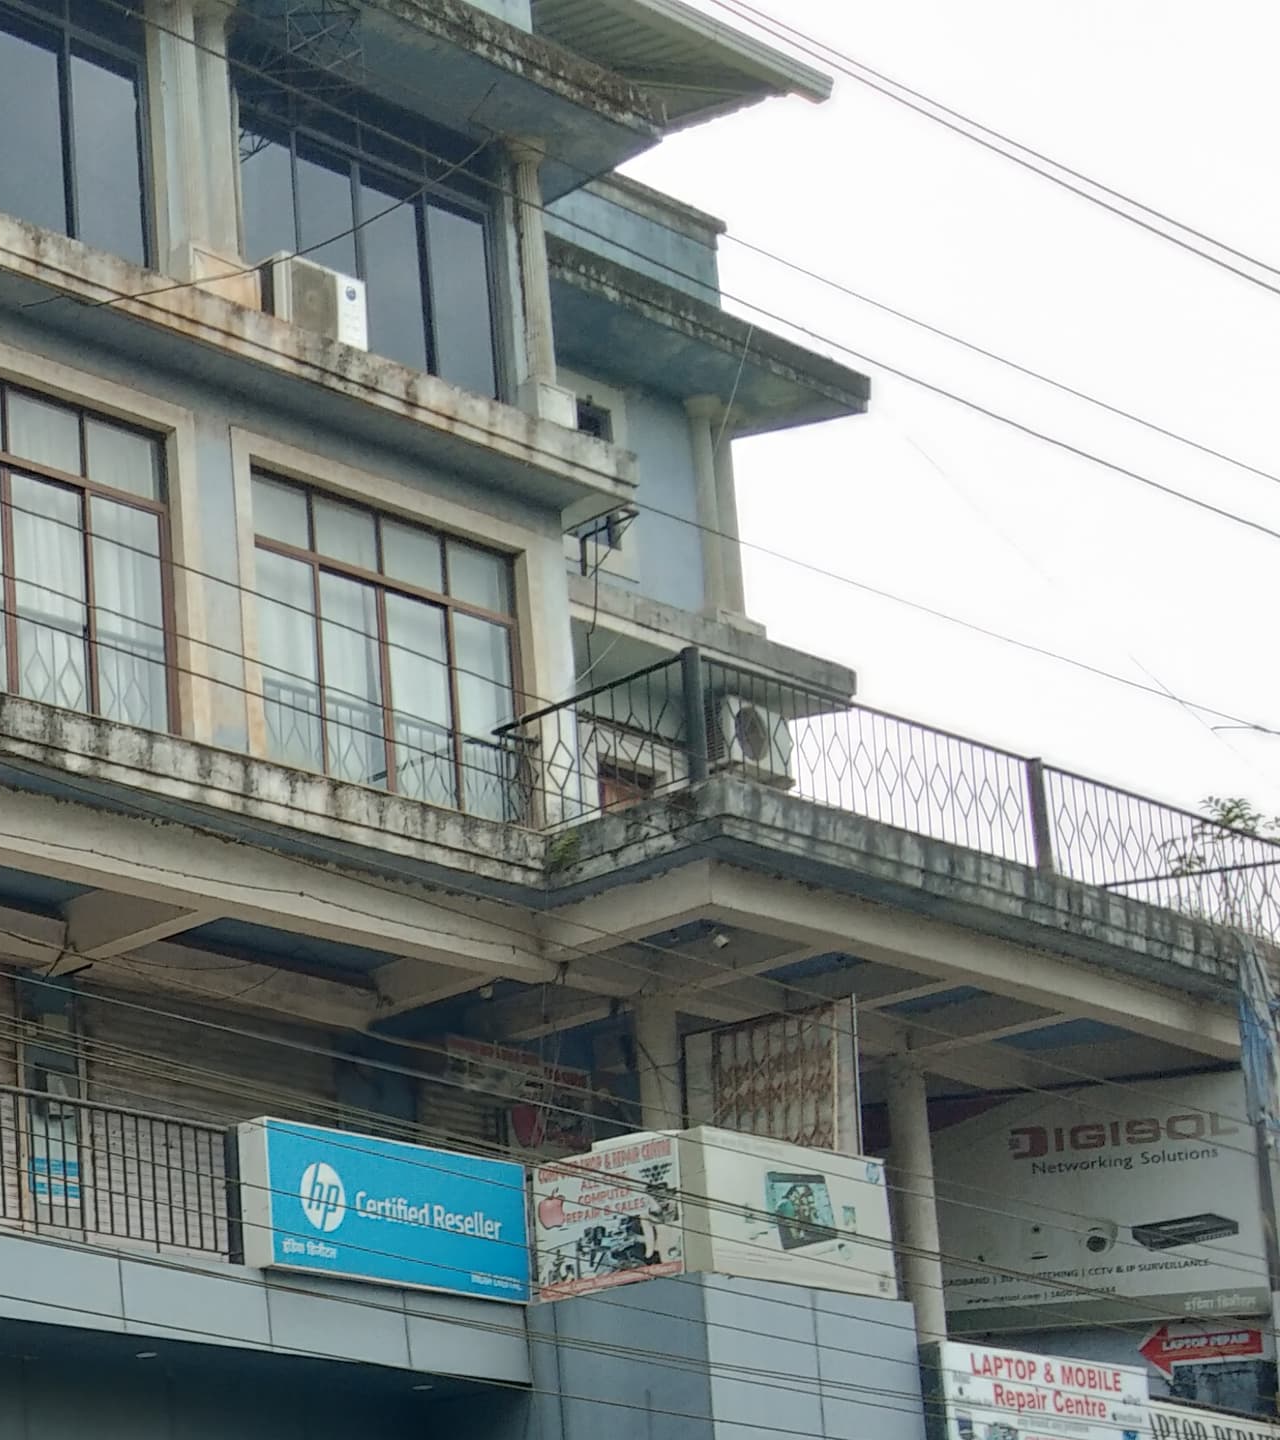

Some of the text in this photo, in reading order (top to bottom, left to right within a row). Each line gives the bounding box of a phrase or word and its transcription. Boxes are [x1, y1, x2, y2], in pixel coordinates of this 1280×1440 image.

[1008, 1112, 1240, 1160] DIGISOL
[1031, 1147, 1220, 1176] Networking Solutions
[355, 1191, 503, 1240] Certified Reseller
[970, 1352, 1037, 1381] LAPTOP
[1044, 1362, 1055, 1384] &
[1061, 1365, 1122, 1392] MOBILE
[993, 1383, 1048, 1413] Repair
[1053, 1389, 1107, 1418] Centre
